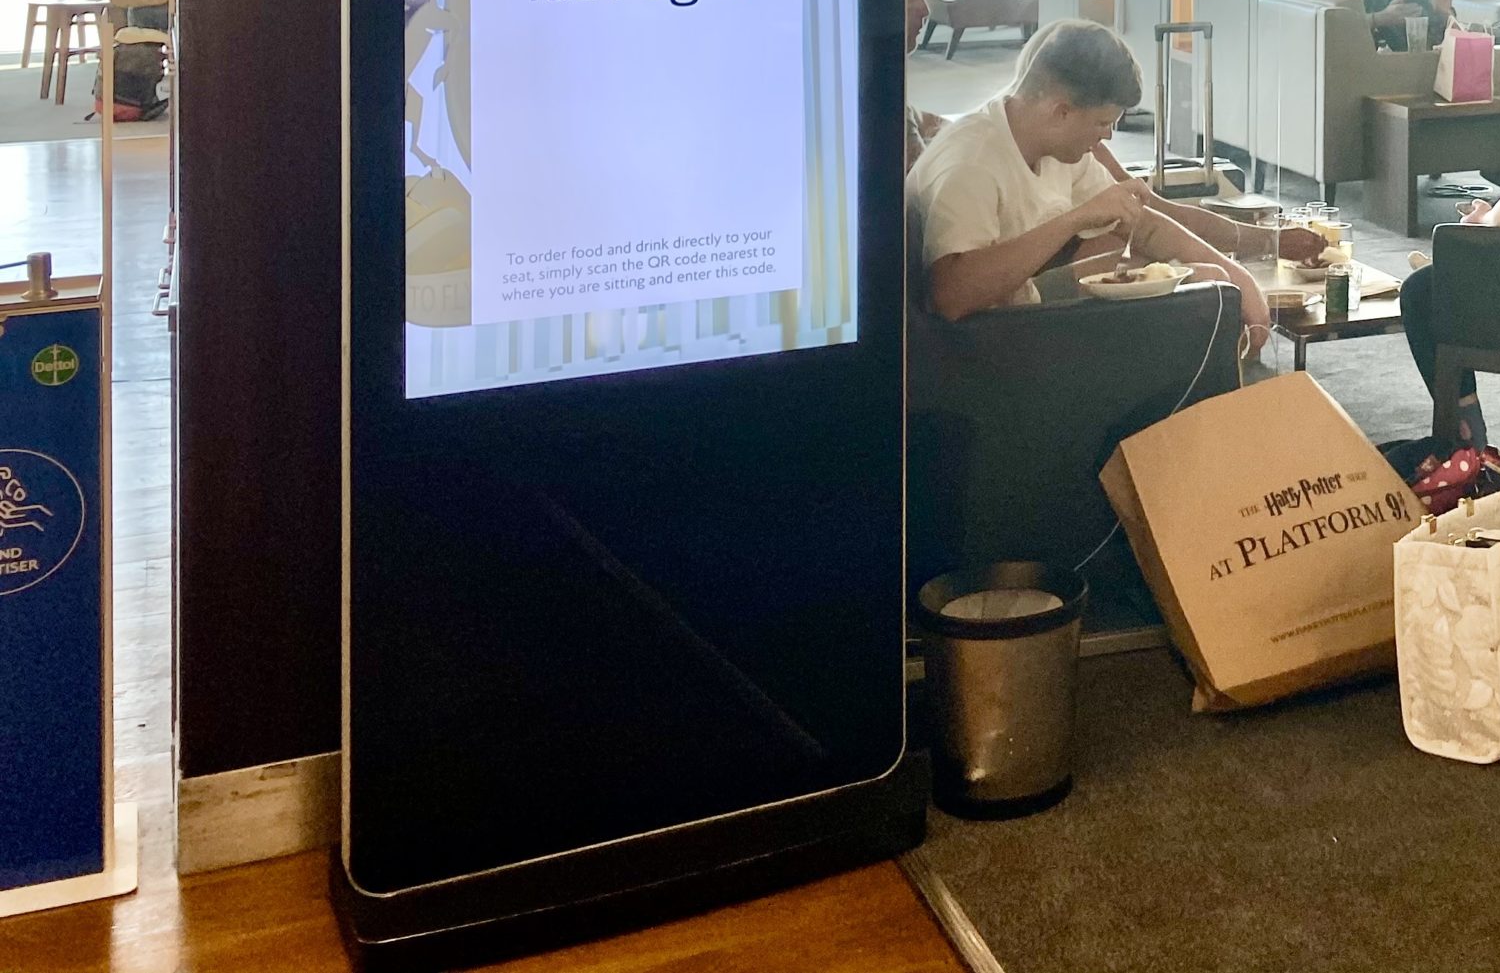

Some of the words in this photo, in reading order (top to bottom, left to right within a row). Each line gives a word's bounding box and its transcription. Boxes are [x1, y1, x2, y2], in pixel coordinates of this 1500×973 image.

[502, 271, 535, 284] seat,
[539, 264, 583, 282] simply
[587, 262, 617, 276] scan
[622, 259, 644, 272] the
[648, 255, 671, 270] QR
[674, 251, 707, 266] code
[711, 247, 758, 263] nearest
[762, 245, 776, 257] to
[506, 252, 525, 266] To
[528, 248, 568, 264] order
[571, 244, 603, 259] food
[607, 241, 632, 256] and
[635, 238, 669, 253] drink
[673, 233, 722, 250] directly
[725, 233, 739, 244] to
[743, 229, 772, 245] your
[409, 285, 436, 312] TO
[442, 283, 471, 311] FL
[502, 288, 545, 302] where
[549, 284, 575, 299] you
[578, 281, 600, 294] are
[604, 276, 646, 291] sitting
[649, 271, 673, 286] and
[677, 268, 712, 283] enter
[715, 264, 739, 279] this
[742, 260, 777, 276] code.
[33, 358, 76, 373] Dettol
[1264, 486, 1301, 517] Harry
[1298, 472, 1344, 511] Potter
[1208, 558, 1233, 581] AT
[1234, 501, 1387, 569] PLATFORM
